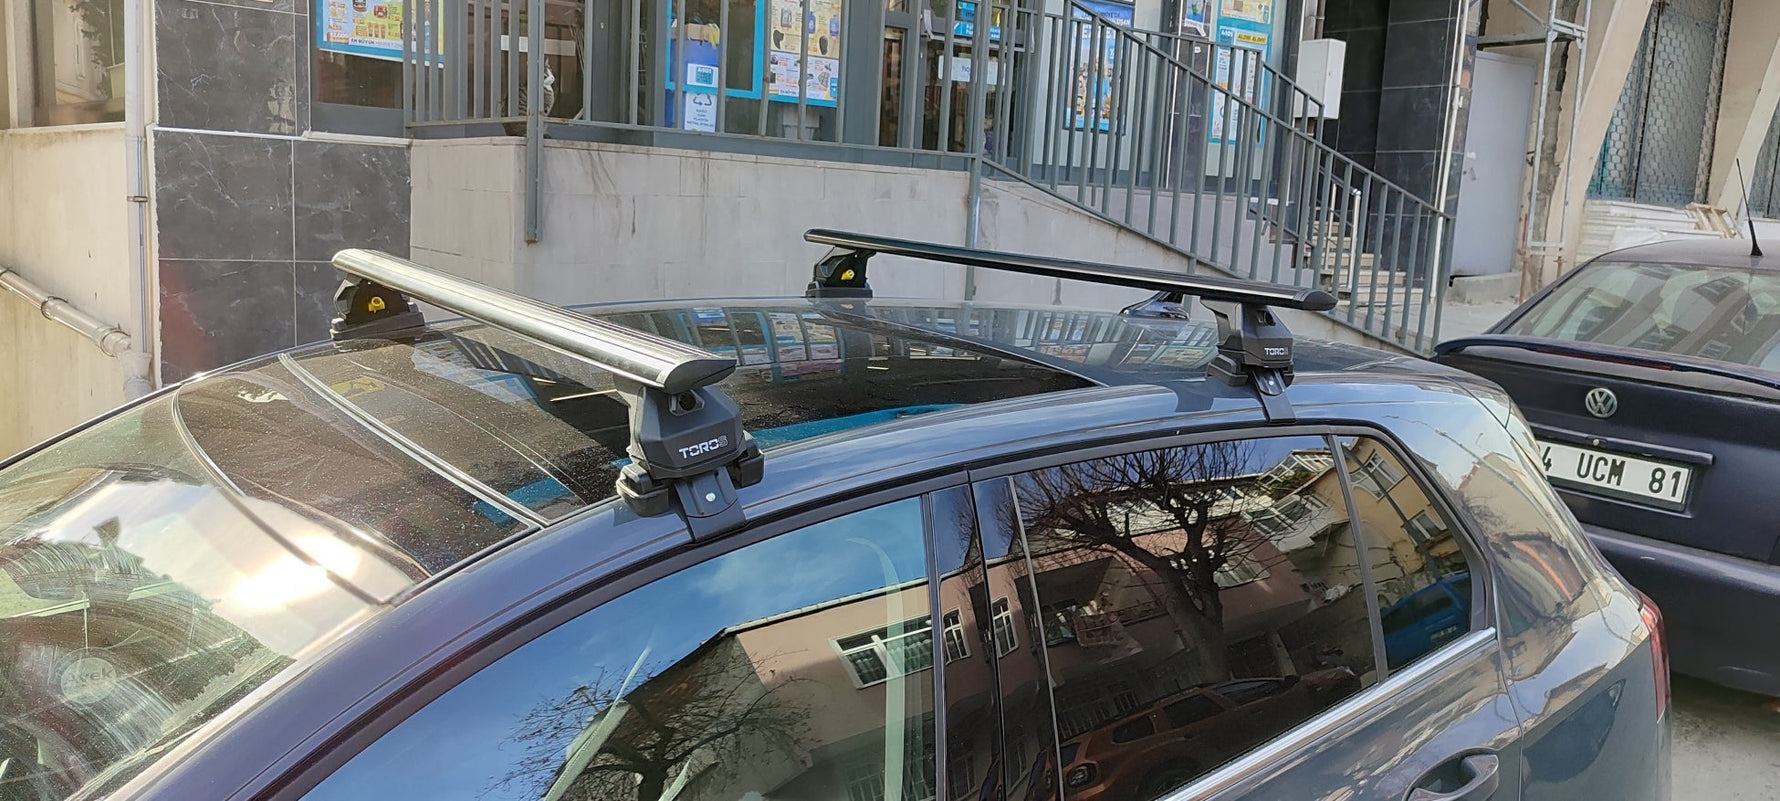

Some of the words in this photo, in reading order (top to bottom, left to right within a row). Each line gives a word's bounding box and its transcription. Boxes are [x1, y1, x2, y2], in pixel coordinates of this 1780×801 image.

[678, 435, 729, 459] TOROS
[1541, 446, 1553, 471] 4
[1576, 452, 1627, 487] UCM
[1648, 467, 1682, 498] 81
